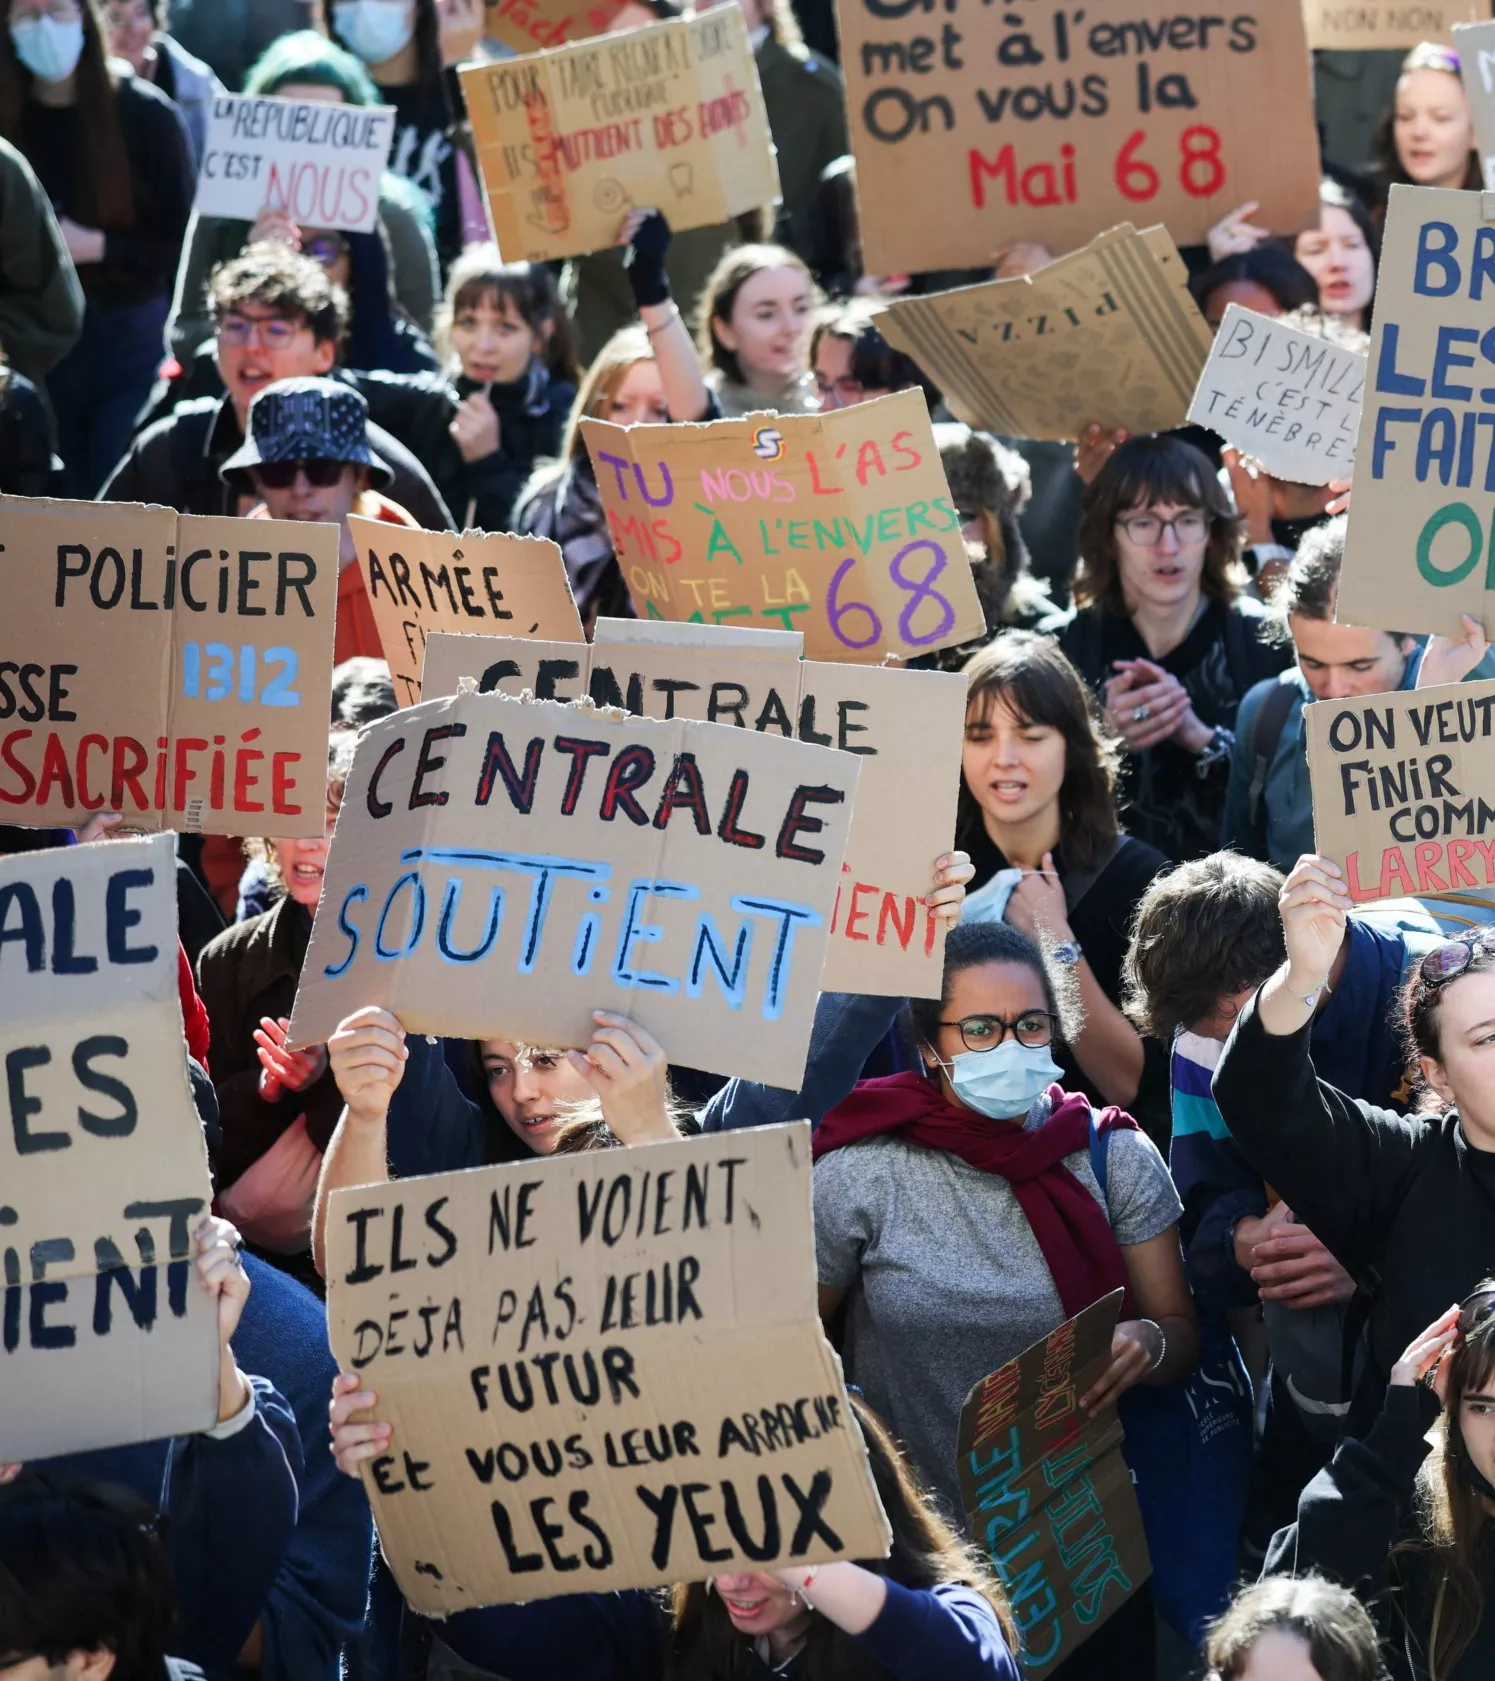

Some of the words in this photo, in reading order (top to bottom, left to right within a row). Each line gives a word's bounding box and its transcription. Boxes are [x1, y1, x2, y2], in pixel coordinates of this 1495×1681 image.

[861, 23, 965, 77] met
[996, 12, 1045, 66] à
[1054, 10, 1258, 62] l'envers
[863, 87, 956, 143] On
[975, 73, 1110, 122] vous
[1136, 61, 1199, 114] la
[265, 161, 371, 225] NOUS
[967, 141, 1079, 210] Mai
[957, 291, 1120, 347] PIZZA
[1256, 381, 1333, 420] C'EST
[598, 450, 674, 507] TU
[700, 468, 795, 503] NOUS
[805, 430, 922, 496] L'AS
[609, 508, 682, 564] MIS
[694, 502, 743, 565] À
[759, 497, 958, 556] L'ENVERS
[369, 548, 513, 619] ARMÉE
[630, 566, 669, 603] ON
[680, 578, 731, 608] TE
[761, 568, 811, 604] LA
[826, 539, 956, 649] 68
[183, 642, 300, 707] 1312
[1329, 708, 1396, 752] ON
[366, 723, 845, 865] CENTRALE
[6, 1035, 139, 1156] ES
[346, 1196, 458, 1285] ILS
[488, 1179, 545, 1256] NE
[577, 1157, 749, 1248] VOIENT
[493, 1276, 577, 1350] PAS
[600, 1255, 703, 1334] LEUR
[471, 1346, 641, 1413] FUTUR
[465, 1433, 595, 1484] VOUS
[605, 1421, 700, 1470] LEUR
[717, 1396, 846, 1459] ARRACHE
[492, 1489, 614, 1574] LES
[637, 1468, 845, 1572] YEUX
[968, 1427, 1063, 1668] CENTRALE
